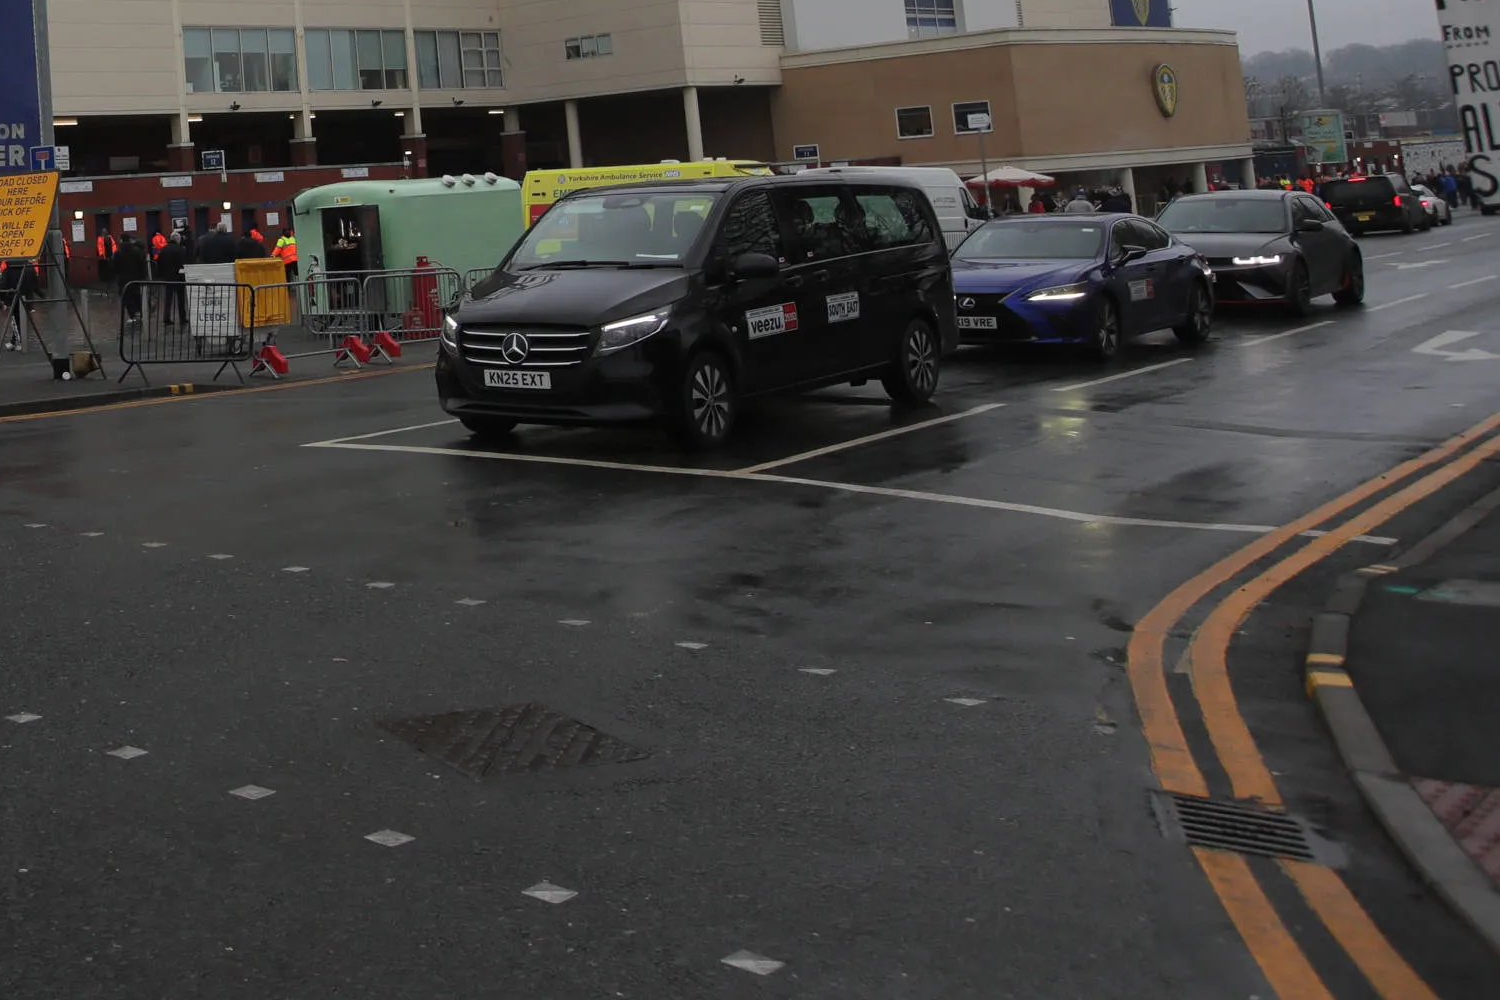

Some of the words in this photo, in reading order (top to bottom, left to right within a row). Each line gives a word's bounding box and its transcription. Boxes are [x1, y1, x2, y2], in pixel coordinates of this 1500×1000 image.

[638, 170, 663, 179] Service
[664, 170, 681, 178] NHS
[16, 175, 49, 186] CLOSED
[7, 187, 29, 197] HERE
[14, 195, 47, 206] BEFORE
[15, 206, 32, 216] OFF
[2, 221, 21, 230] WILL
[23, 220, 36, 229] BE
[0, 239, 21, 248] SAFE
[23, 238, 34, 247] TO
[1, 248, 13, 257] SO
[828, 303, 845, 318] SOUTH
[846, 300, 859, 313] EAST
[199, 313, 227, 322] LEEDS
[972, 317, 994, 328] VRE
[489, 371, 518, 385] KN25
[521, 372, 545, 387] EXT
